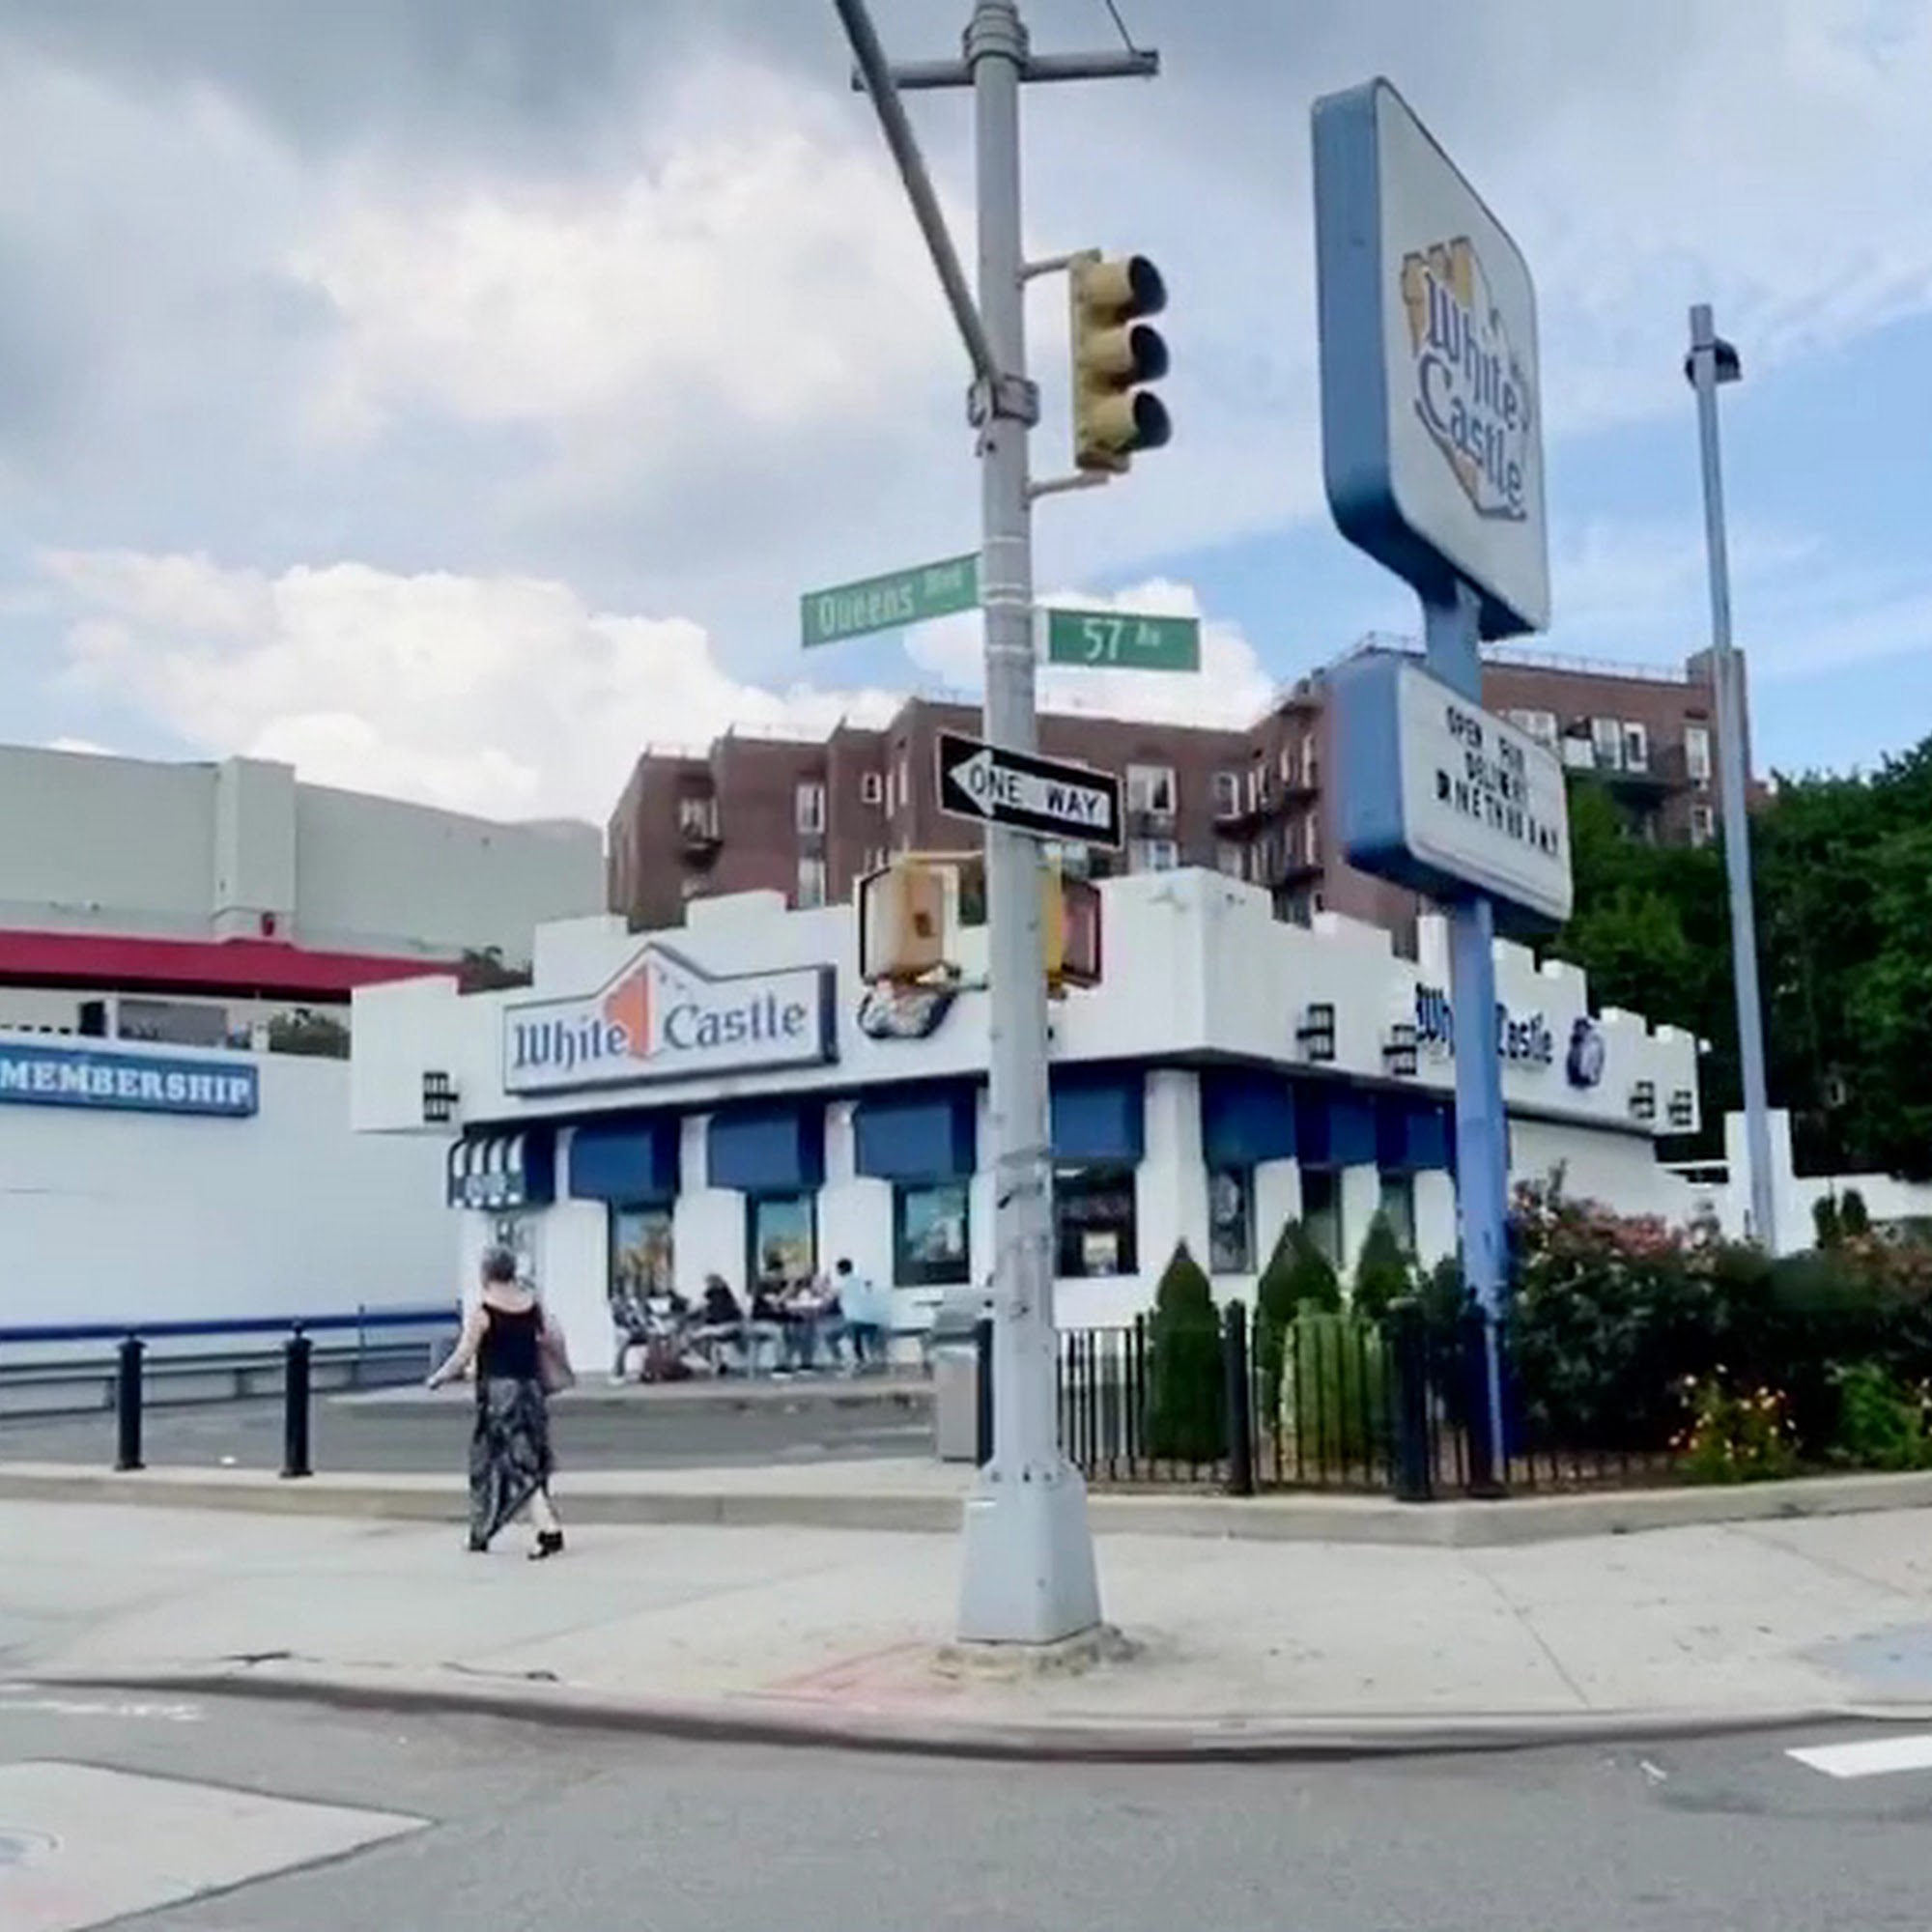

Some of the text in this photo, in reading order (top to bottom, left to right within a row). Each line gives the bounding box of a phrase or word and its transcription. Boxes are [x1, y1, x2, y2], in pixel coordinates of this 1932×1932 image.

[1425, 268, 1519, 432] White
[1418, 353, 1522, 507] Castle
[818, 582, 915, 636] Queens
[1083, 618, 1124, 661] 57
[970, 762, 1099, 819] ONE WAY
[513, 989, 808, 1069] White Castle
[0, 1059, 250, 1105] MEMBERSHIP
